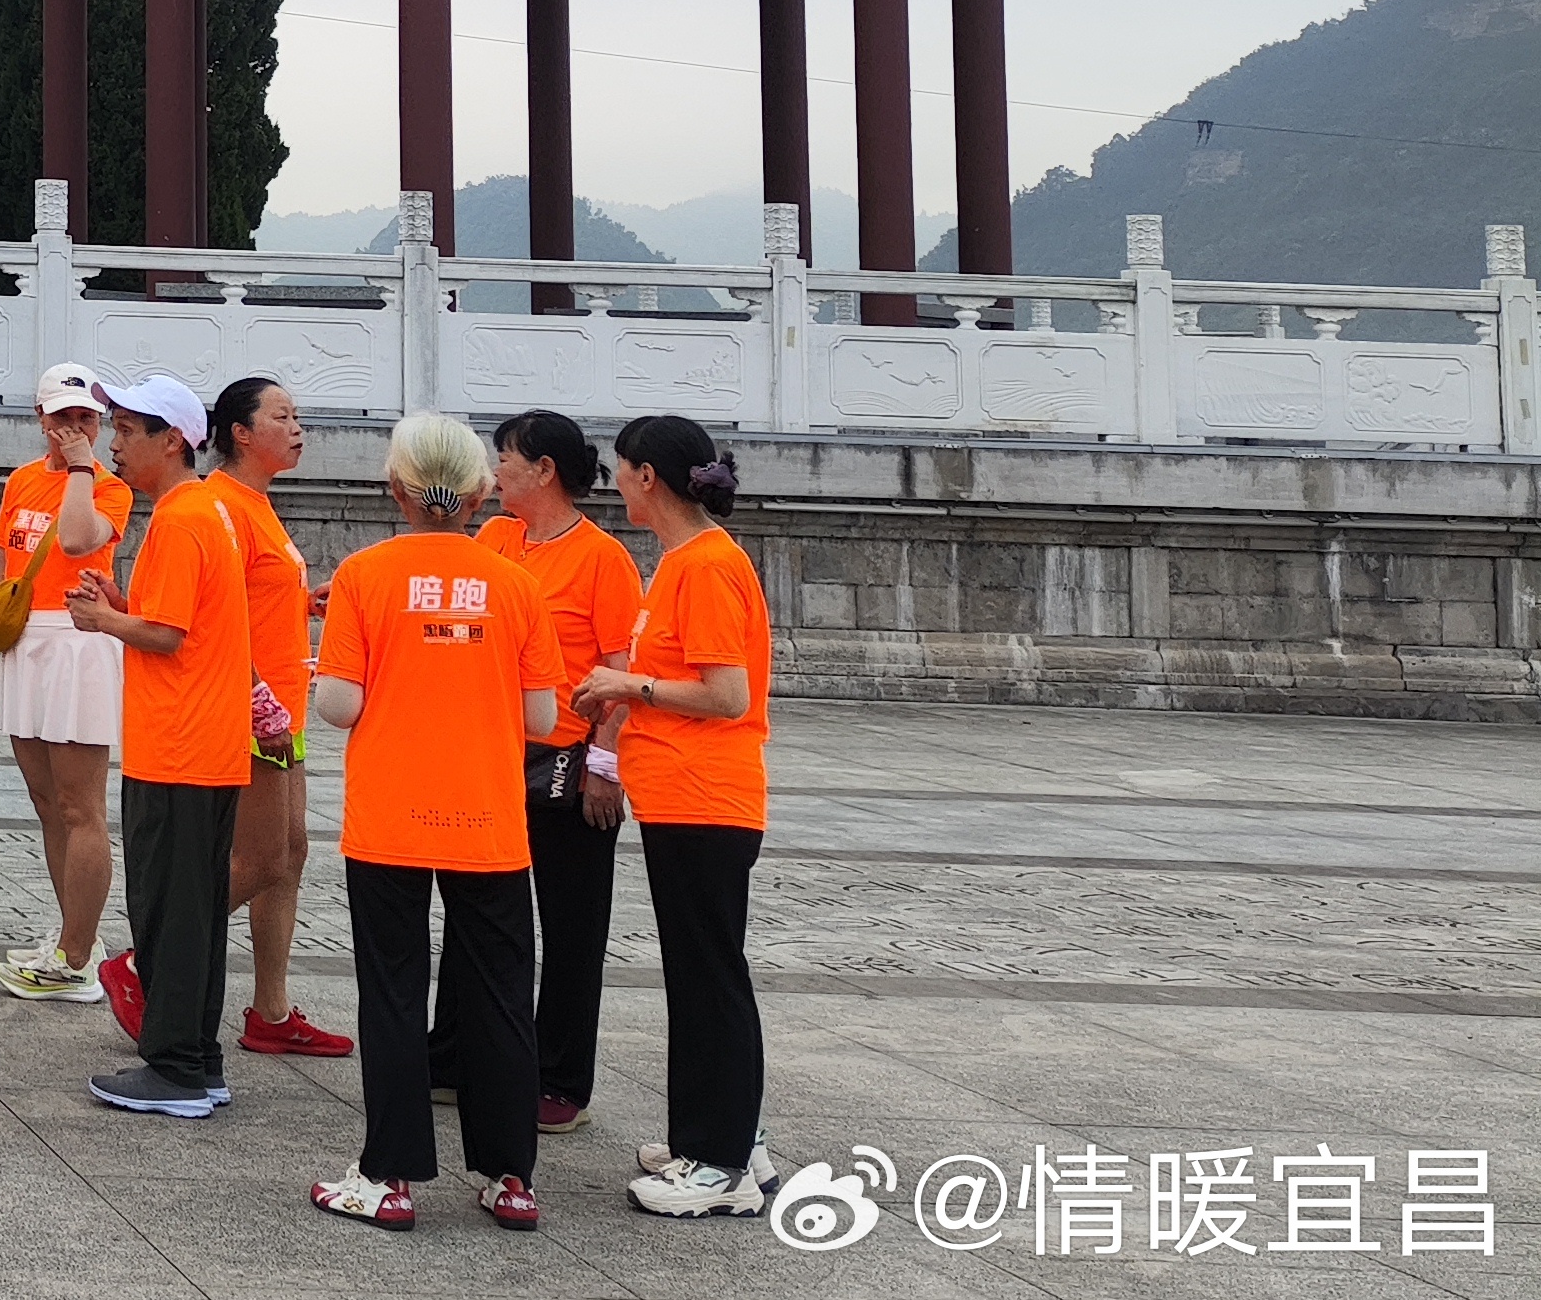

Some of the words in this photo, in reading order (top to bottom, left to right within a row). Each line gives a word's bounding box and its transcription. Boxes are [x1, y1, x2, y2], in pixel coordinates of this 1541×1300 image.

[13, 509, 54, 533] 黑暗
[8, 529, 46, 553] 跑团
[407, 575, 487, 612] 陪跑
